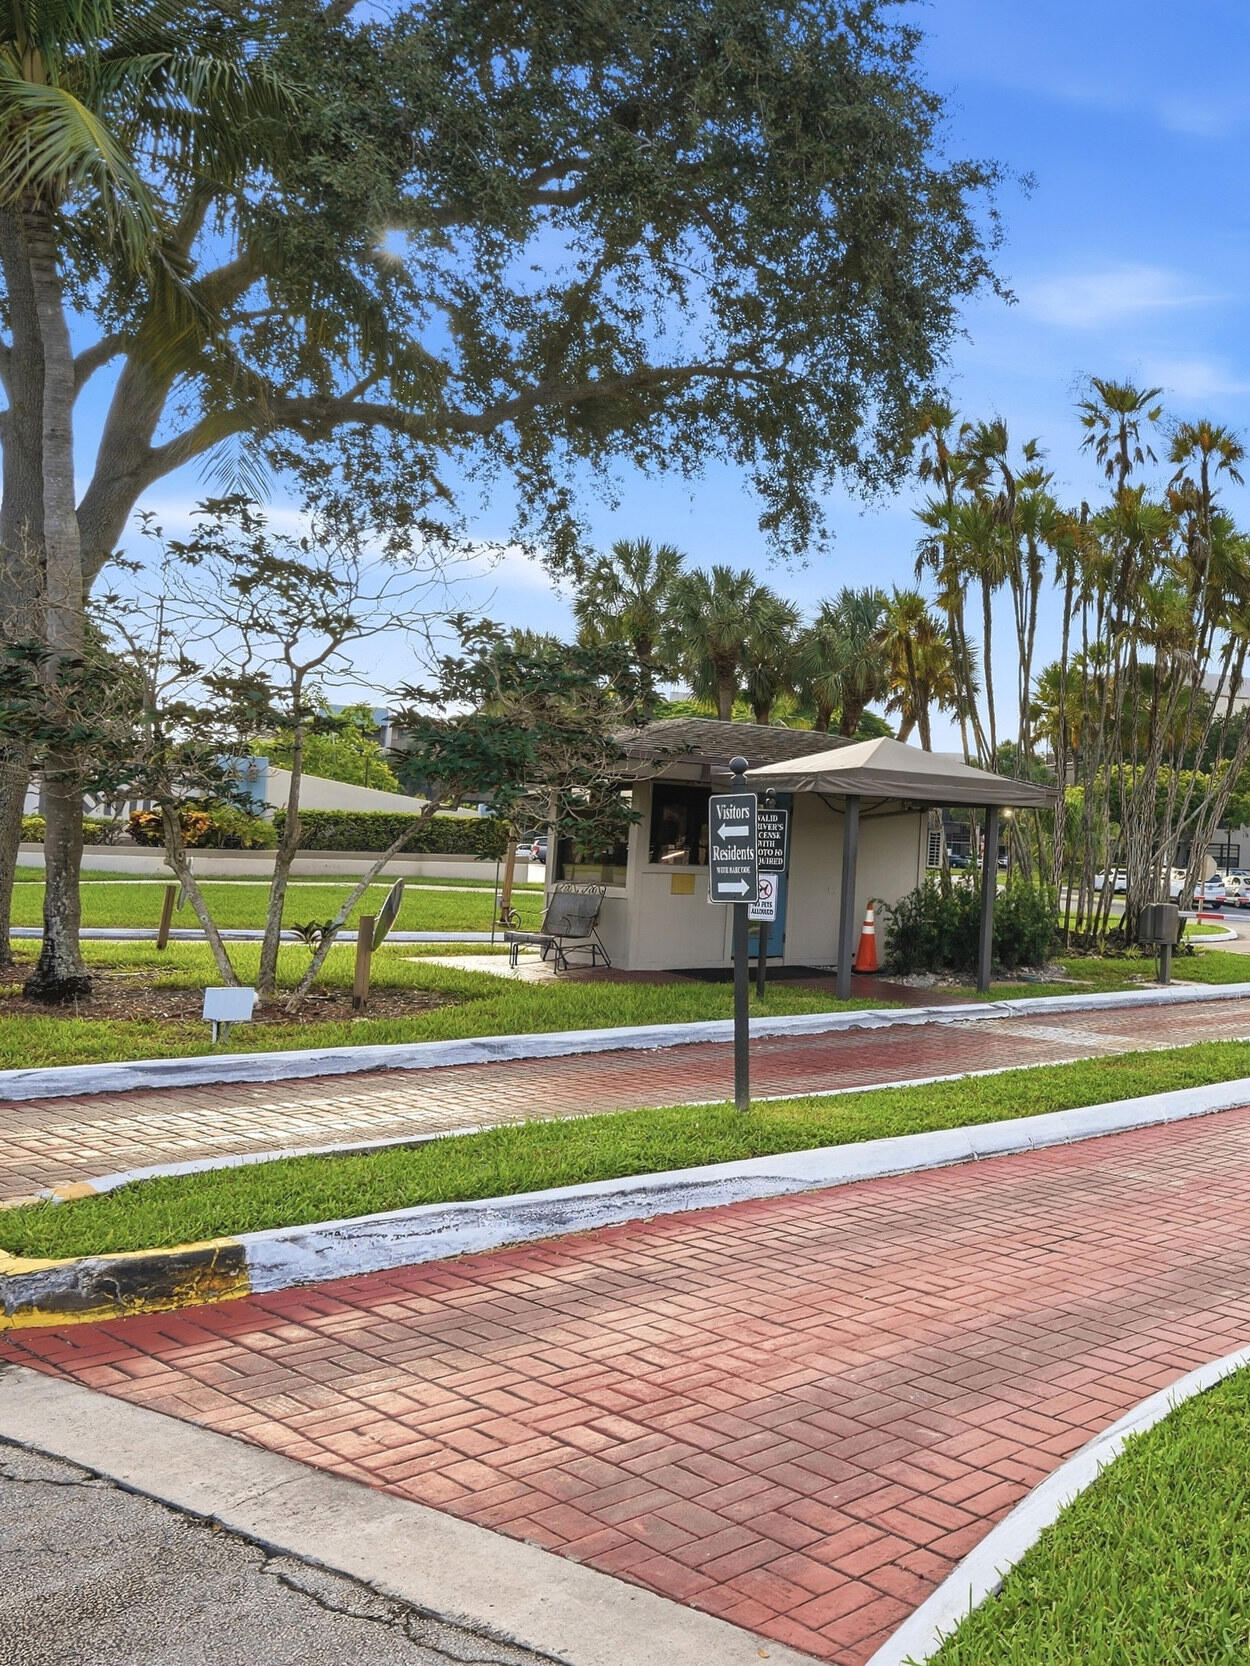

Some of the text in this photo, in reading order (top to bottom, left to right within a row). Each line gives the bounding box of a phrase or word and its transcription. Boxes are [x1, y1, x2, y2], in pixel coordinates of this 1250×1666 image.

[716, 804, 750, 819] Visitors
[757, 823, 784, 831] IVER'S
[758, 831, 781, 839] CENSE
[712, 844, 755, 861] Residents
[757, 848, 774, 856] OTO
[758, 857, 784, 865] UIRED
[729, 866, 751, 874] BARCODE
